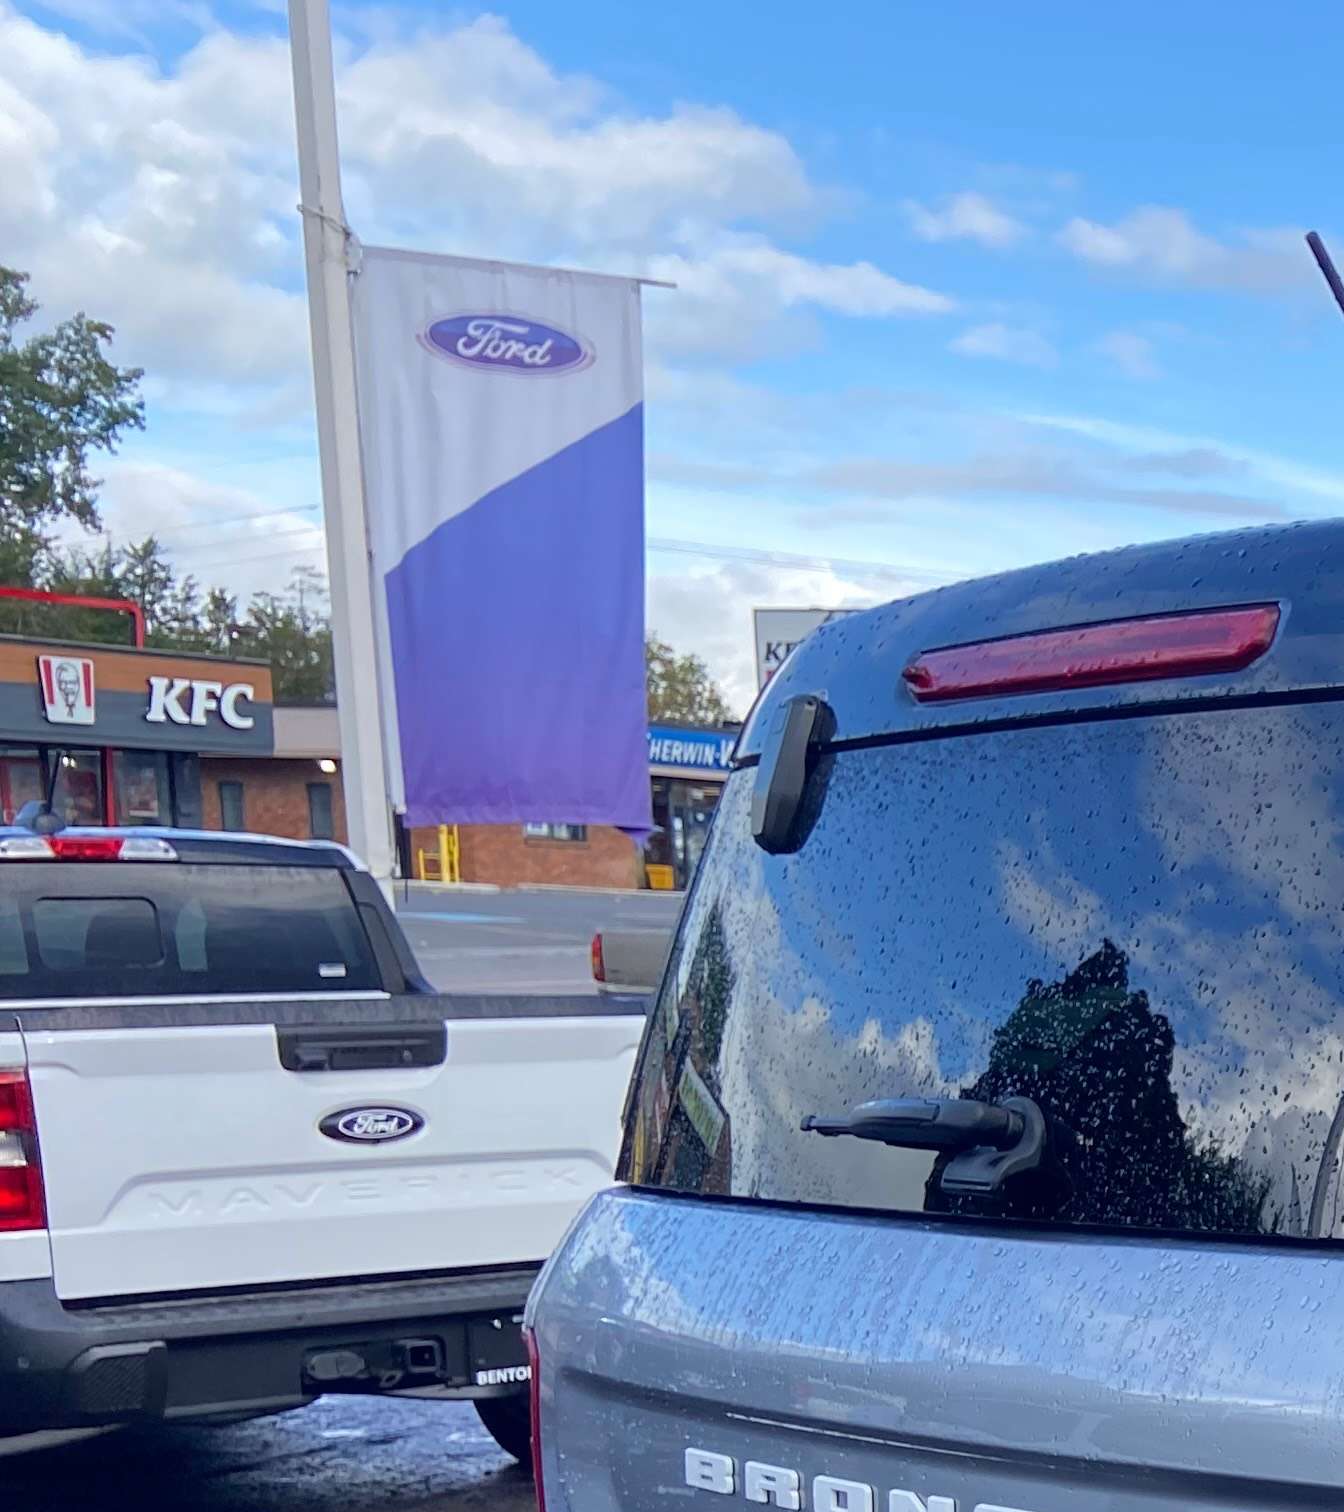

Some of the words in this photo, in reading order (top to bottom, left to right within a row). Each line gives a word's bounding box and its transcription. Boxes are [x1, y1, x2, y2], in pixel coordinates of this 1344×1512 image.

[456, 318, 555, 366] Ford
[145, 676, 255, 730] KFC
[646, 732, 736, 768] HERWIN-W
[352, 1112, 400, 1135] Ford
[147, 1166, 585, 1218] MAVERICK
